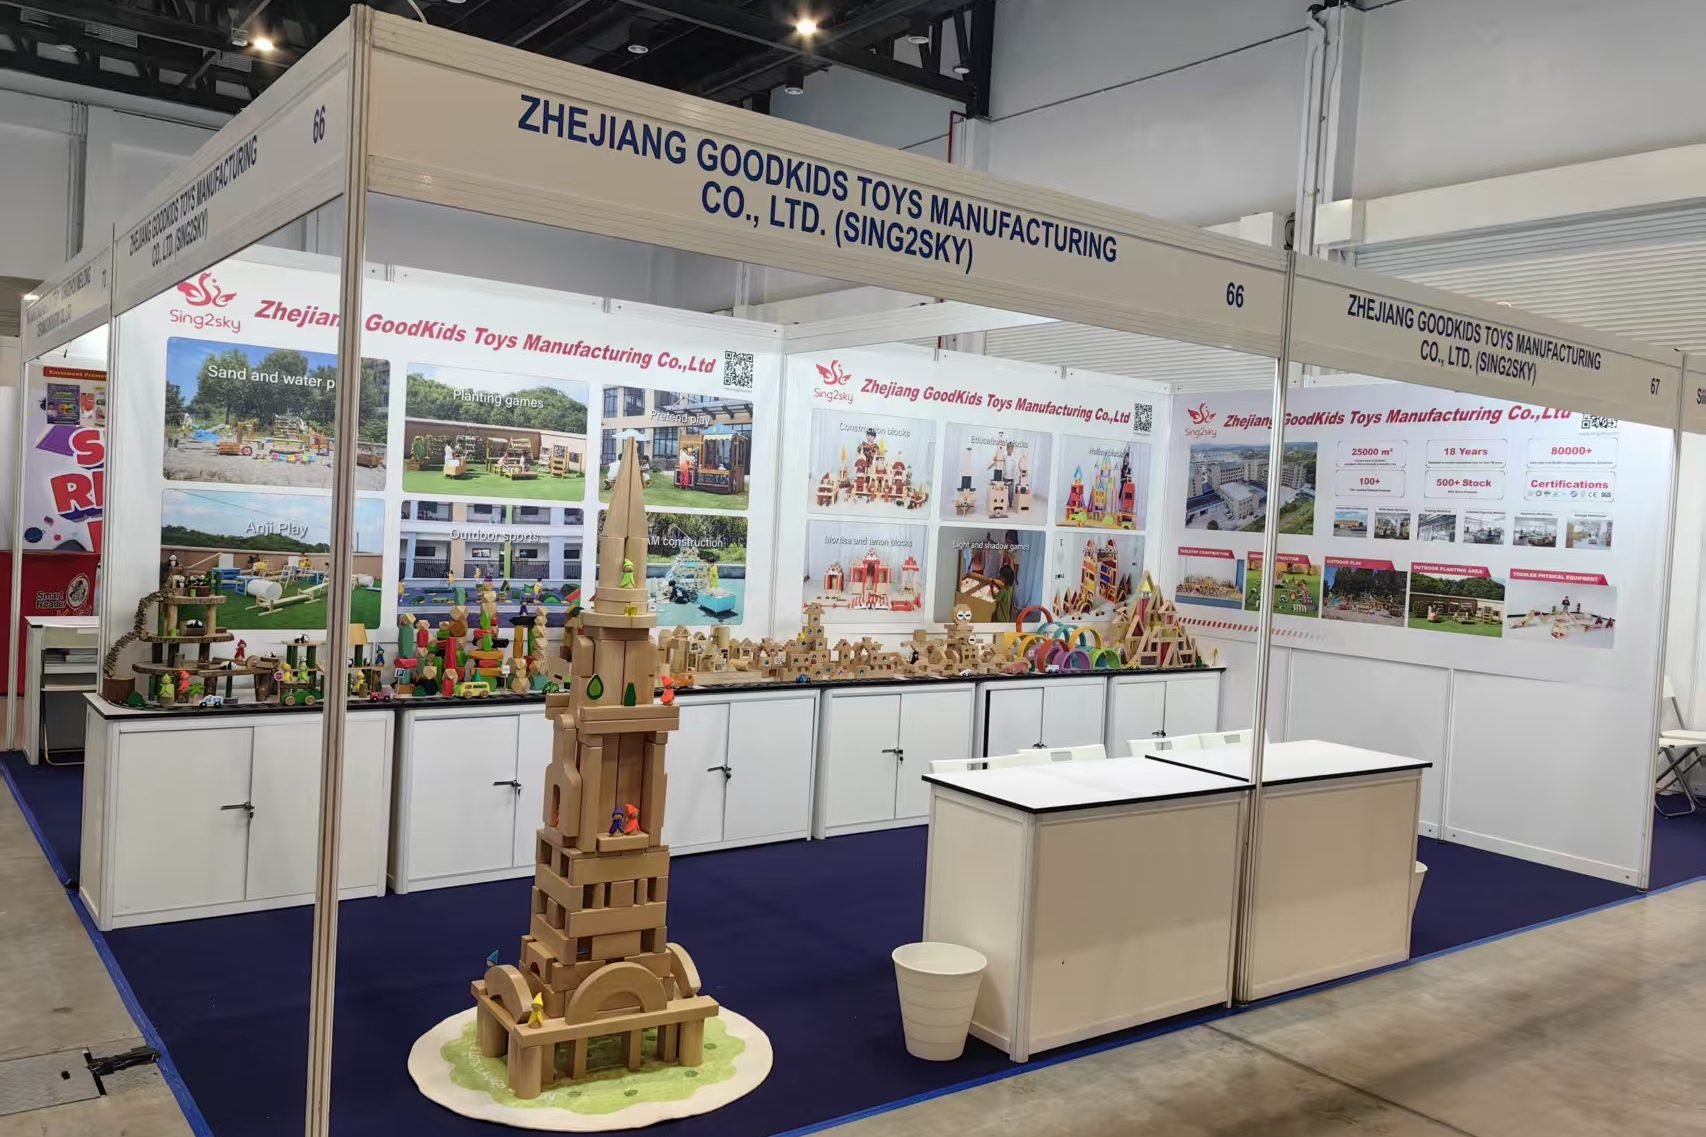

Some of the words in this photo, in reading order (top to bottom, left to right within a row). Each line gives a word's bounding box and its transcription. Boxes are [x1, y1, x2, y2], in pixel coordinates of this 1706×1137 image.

[313, 105, 326, 144] 66
[180, 185, 196, 218] TOYS
[196, 134, 258, 208] MANUFACTURING
[519, 94, 689, 165] ZHEJIANG
[696, 136, 849, 202] GOODKIDS
[857, 176, 923, 220] TOYS
[929, 195, 1118, 263] MANUFACTURING
[701, 180, 760, 228] CO.,
[769, 197, 827, 236] LTD.
[834, 210, 975, 276] (SING2SKY)
[1226, 282, 1245, 309] 66
[169, 309, 241, 333] Sing2sky
[254, 299, 340, 327] Zhejian
[364, 313, 467, 343] GoodKids
[474, 327, 519, 352] Toys
[522, 333, 653, 370] Manufacturing
[656, 351, 717, 376] Co.,Ltd
[1347, 293, 1415, 331] ZHEJIANG
[1417, 309, 1482, 344] GOODKIDS
[1484, 325, 1514, 352] TOYS
[1516, 334, 1602, 371] MANUFACTURING
[1420, 339, 1445, 367] CO.,
[1448, 347, 1474, 370] LTD.
[1475, 351, 1537, 387] (SING2SKY)
[208, 365, 247, 381] Sand
[251, 368, 279, 384] and
[282, 373, 323, 388] water
[814, 388, 854, 404] Sing2sky
[1650, 377, 1660, 396] 67
[453, 388, 502, 408] Planting
[505, 394, 545, 410] games
[861, 378, 920, 401] Zhejiang
[923, 386, 983, 407] GoodKids
[986, 393, 1013, 412] Toys
[1014, 398, 1093, 421] Manufacturing
[1095, 407, 1131, 425] Co.,Ltd
[650, 410, 688, 424] Pretend
[690, 412, 711, 427] play
[1350, 411, 1382, 427] Toys
[1386, 407, 1503, 424] Manufacturing
[1185, 427, 1217, 438] Sing2sky
[1351, 448, 1379, 456] 25000
[1444, 448, 1456, 456] 18
[1459, 448, 1488, 456] Years
[1551, 446, 1593, 455] 80000+
[1360, 477, 1380, 485] 100+
[1436, 478, 1460, 487] 500+
[1462, 479, 1492, 488] Stock
[1531, 479, 1609, 490] Certifications
[245, 520, 274, 536] Anji
[279, 521, 309, 540] Play
[448, 527, 500, 542] Outdoor
[502, 530, 540, 544] sports
[663, 537, 723, 548] construction
[953, 540, 969, 550] Light
[971, 541, 983, 549] and
[984, 541, 1008, 550] shadow
[1009, 544, 1030, 552] games
[36, 591, 64, 600] Smart
